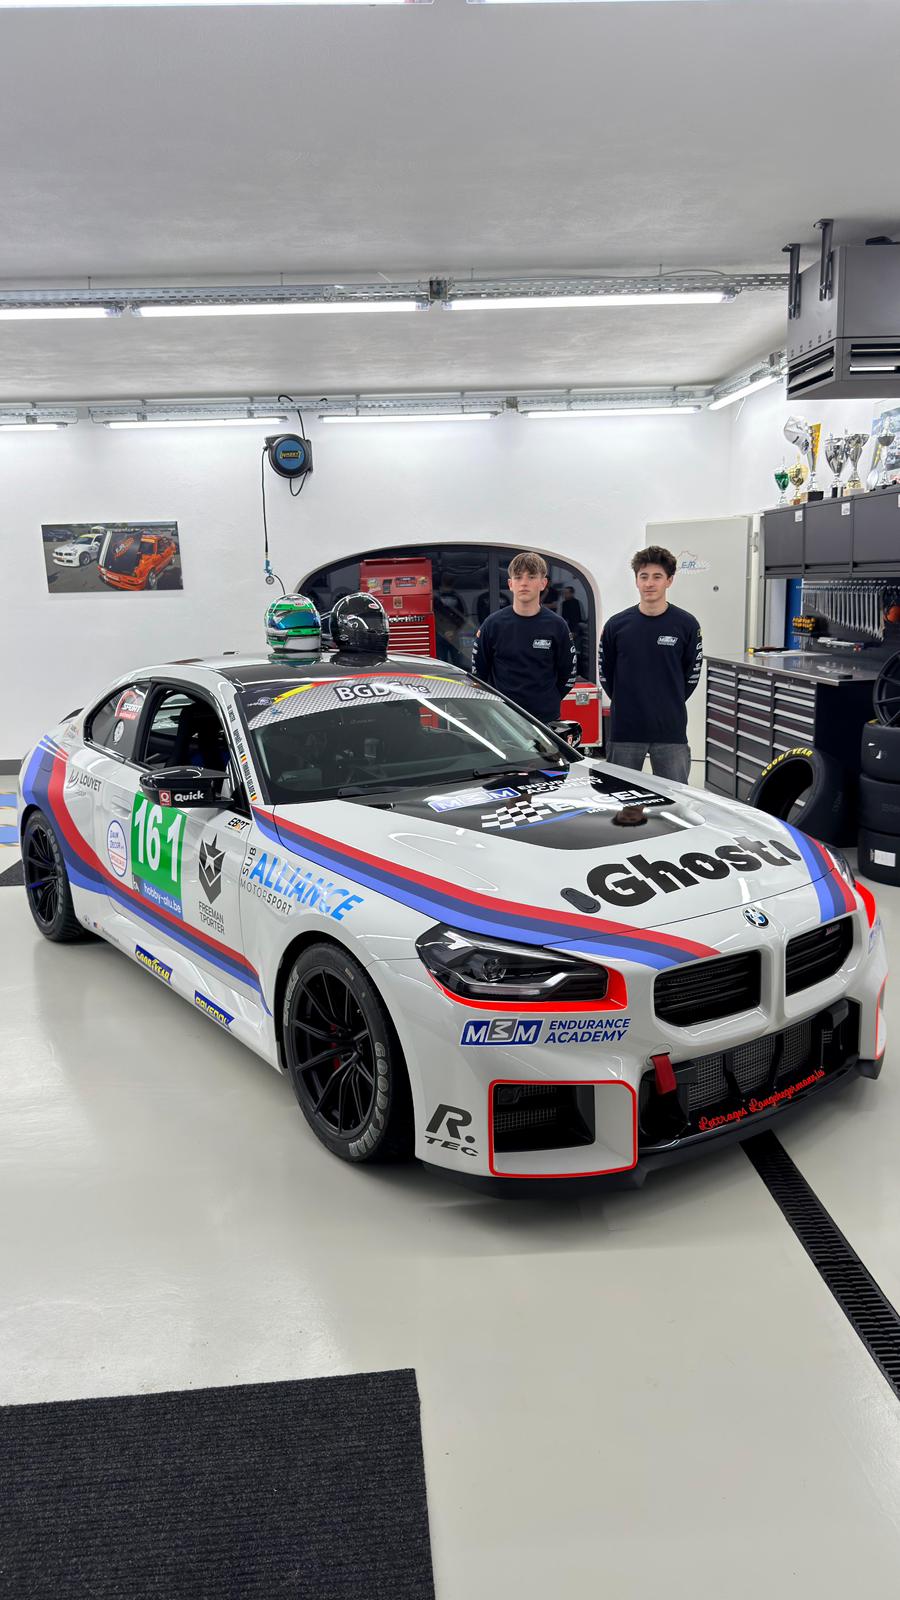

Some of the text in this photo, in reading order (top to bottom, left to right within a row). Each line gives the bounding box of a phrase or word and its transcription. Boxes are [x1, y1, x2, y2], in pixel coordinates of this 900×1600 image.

[761, 747, 813, 777] GOODYEAR
[80, 773, 102, 792] LOUYET
[174, 790, 204, 802] Quick
[135, 799, 183, 882] 161
[242, 847, 257, 877] SUB
[586, 836, 791, 907] Ghost
[143, 882, 182, 913] hobby-alu.be
[241, 880, 293, 916] MOTORSPORT
[250, 852, 365, 921] ALLIANCE
[198, 900, 224, 924] FREEMAN
[544, 1030, 628, 1044] ACADEMY
[549, 1018, 631, 1030] ENDURANCE
[424, 1135, 480, 1157] TEC
